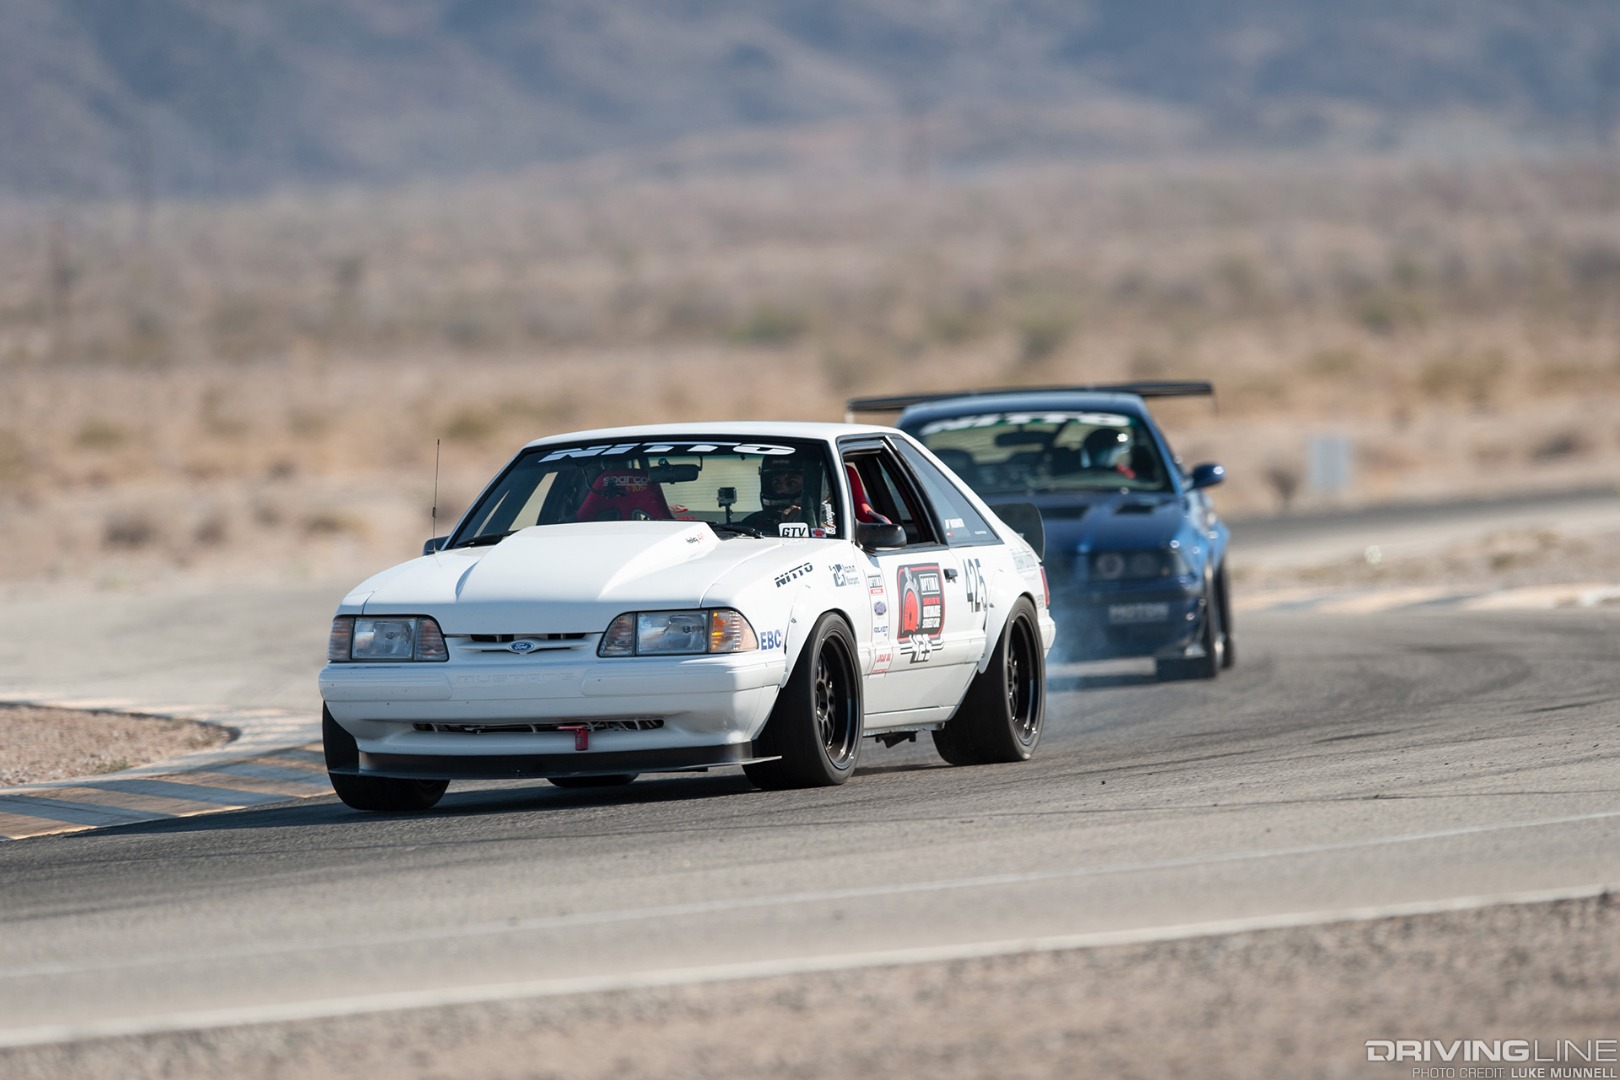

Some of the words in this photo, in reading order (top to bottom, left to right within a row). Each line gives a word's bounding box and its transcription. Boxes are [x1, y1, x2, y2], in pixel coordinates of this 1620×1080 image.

[538, 441, 797, 464] NITTO
[782, 527, 807, 538] GTV
[773, 561, 814, 588] NITTO
[962, 558, 988, 613] 425
[512, 641, 530, 651] Ford
[760, 629, 783, 651] EBC
